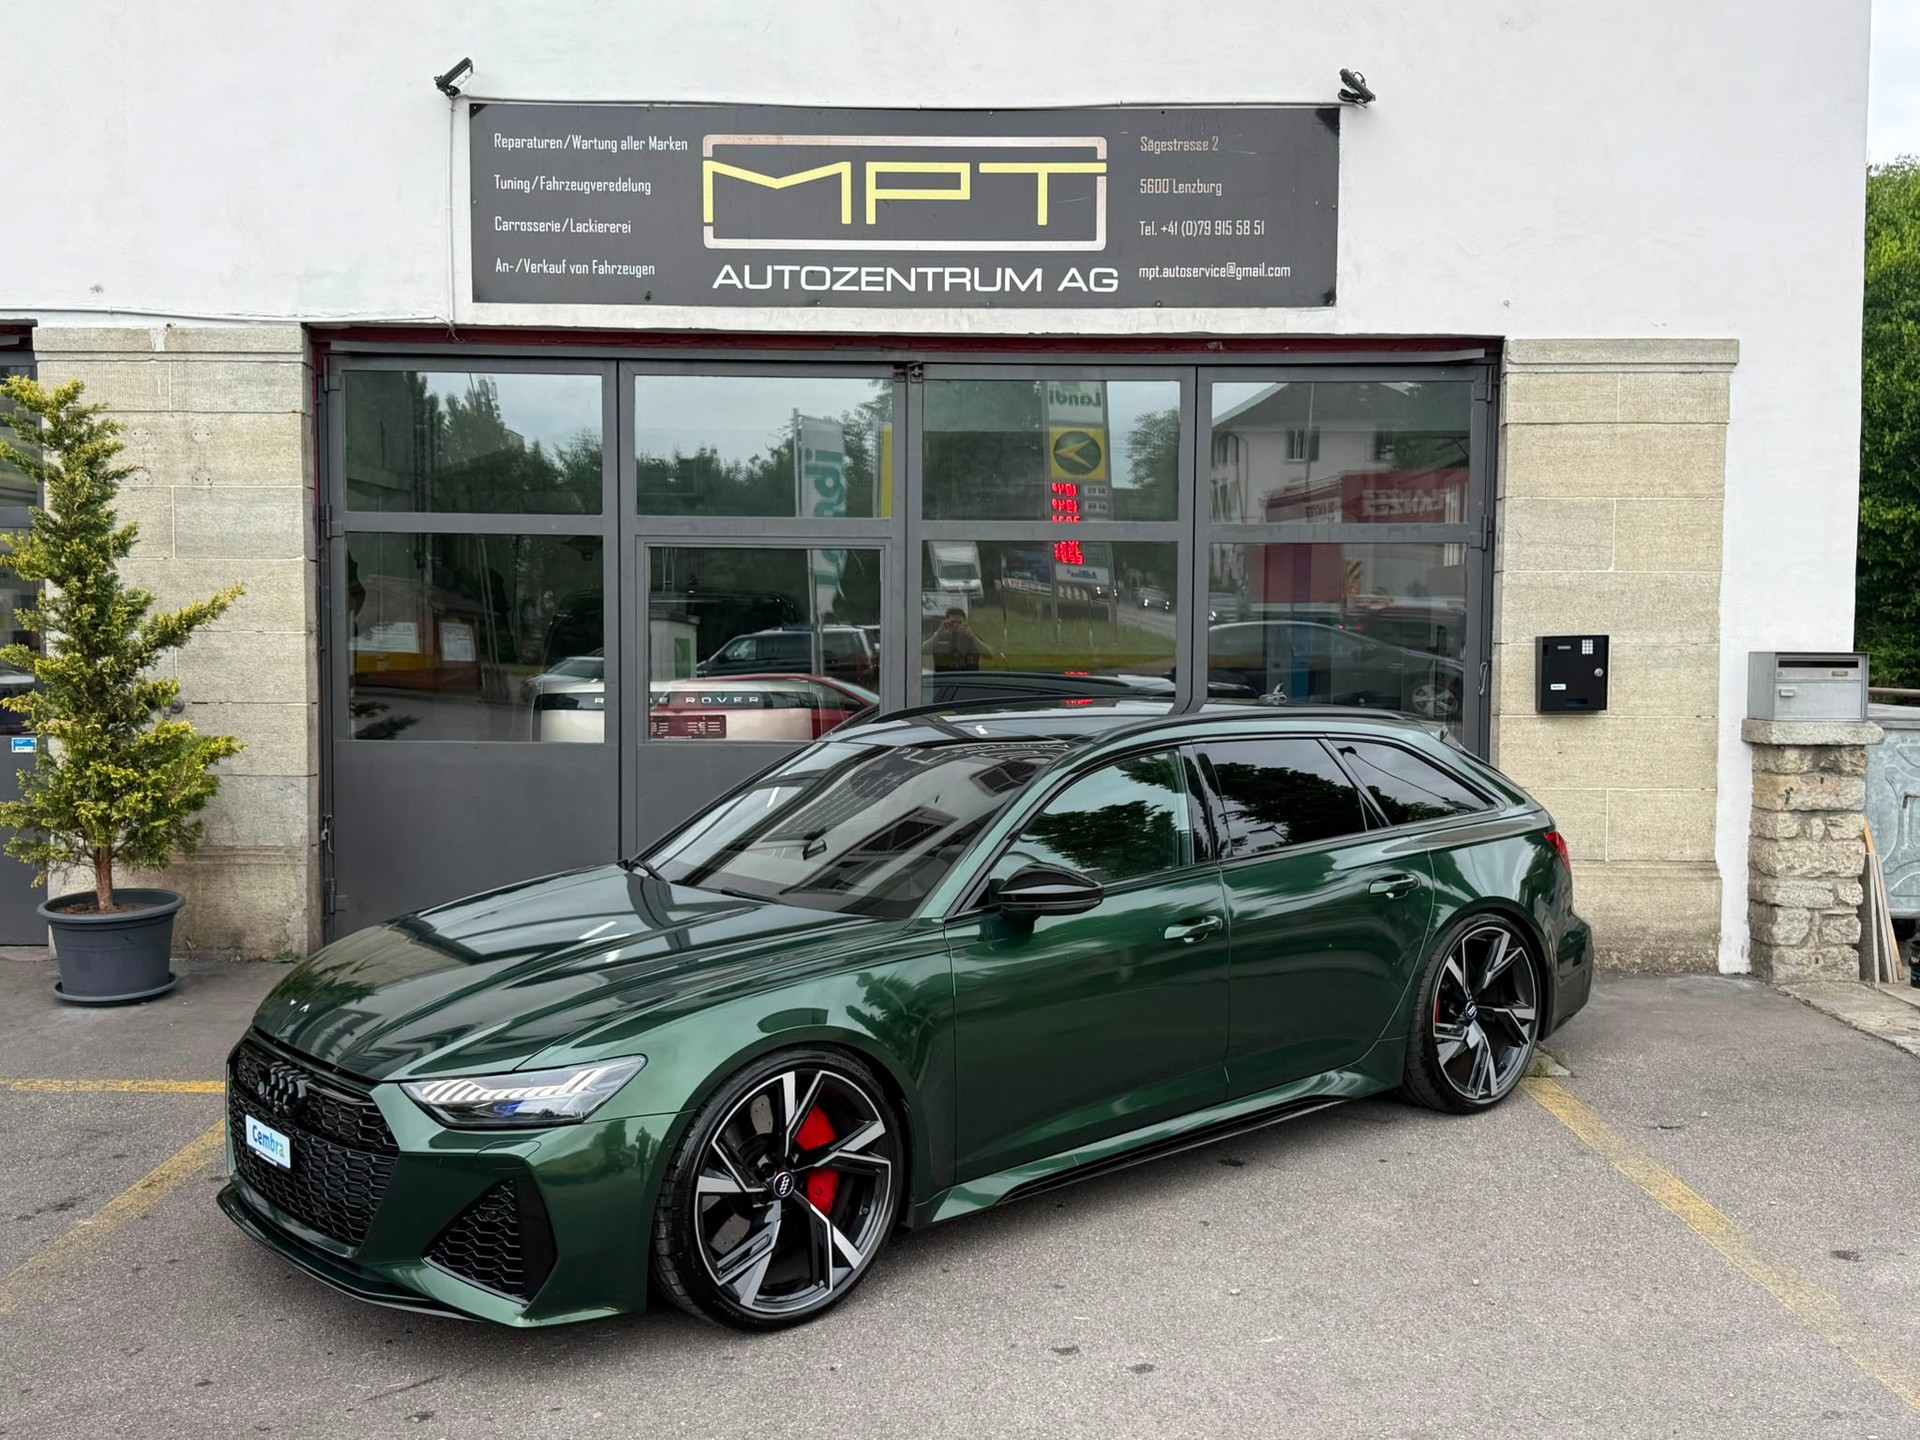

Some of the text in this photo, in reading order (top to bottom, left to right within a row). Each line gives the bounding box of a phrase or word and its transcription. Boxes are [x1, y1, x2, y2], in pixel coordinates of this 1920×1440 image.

[494, 132, 688, 154] Reparaturen/Wartung aller Marken
[1140, 135, 1219, 155] Sägestrasse 2
[493, 173, 652, 196] Tuning/Fahrzeugveredelung
[702, 159, 1108, 226] MPT
[1139, 177, 1223, 197] 5600 Lenzburg
[494, 215, 632, 234] Carrosserie/Lackiererei
[1139, 219, 1265, 238] Tel. +41 (0)79 915 58 51
[495, 257, 656, 279] An-/Verkauf von Fahrzeugen
[711, 264, 1119, 293] AUTOZENTRUM AG
[1138, 261, 1291, 281] mpt.autoservice@gmail.com
[685, 696, 759, 704] ROVER
[252, 1124, 285, 1158] Cembra
